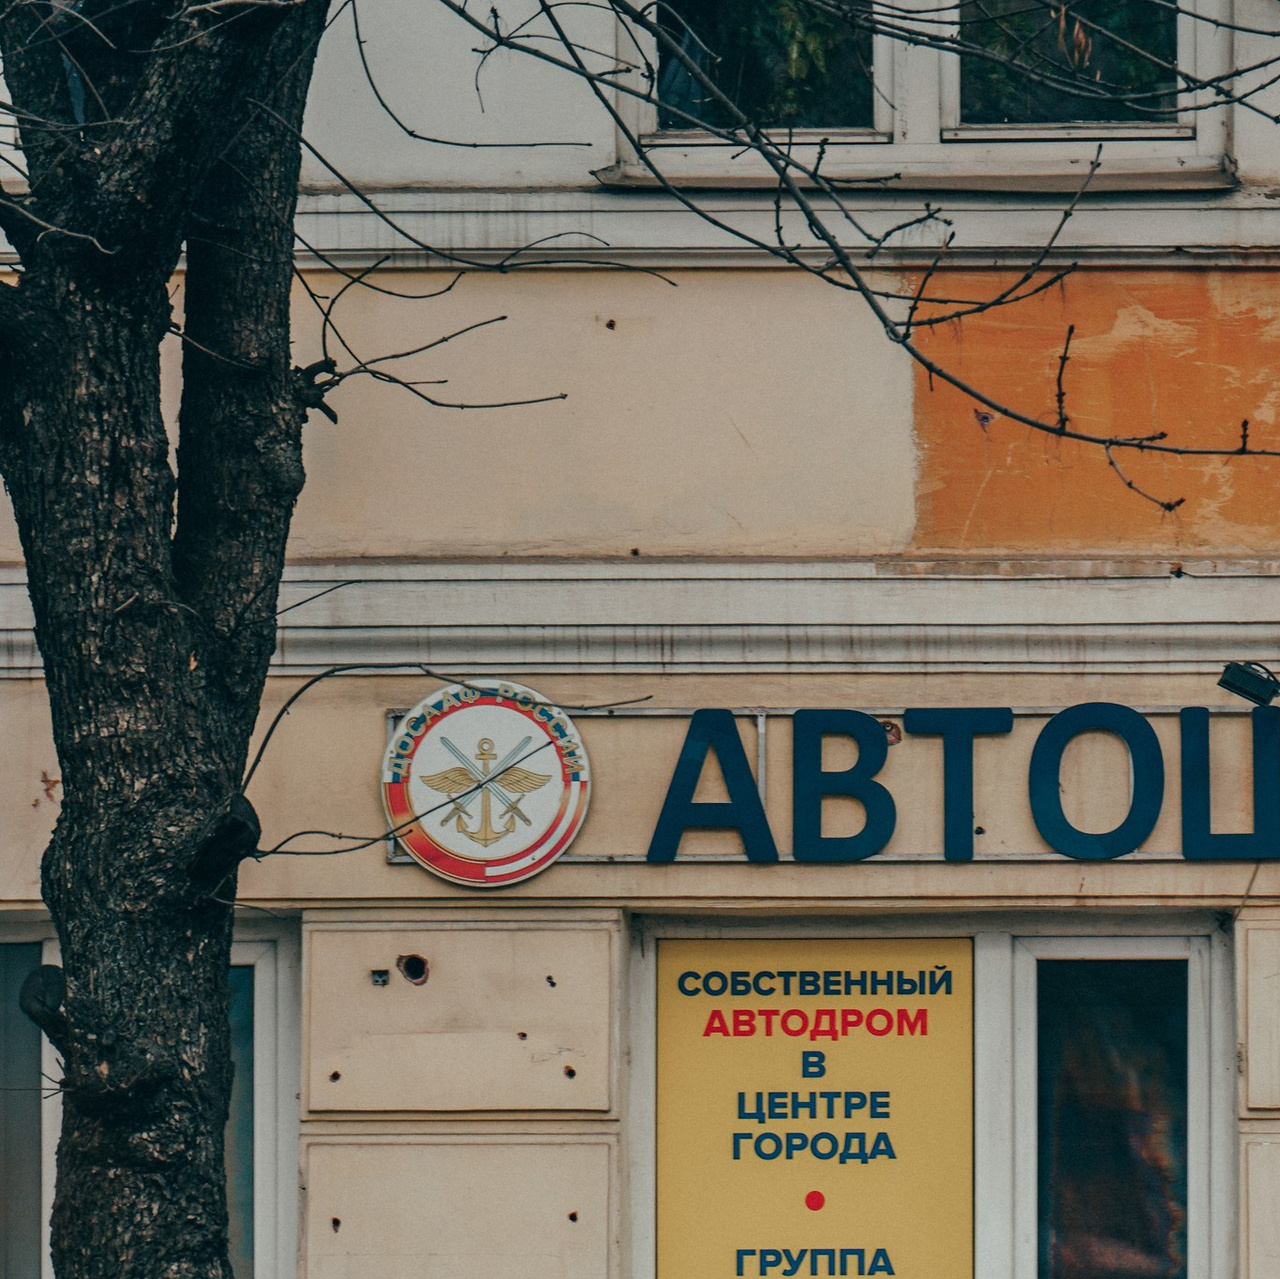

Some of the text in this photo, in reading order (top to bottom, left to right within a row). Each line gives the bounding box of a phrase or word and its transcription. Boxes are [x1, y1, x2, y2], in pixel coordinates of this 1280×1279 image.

[388, 683, 585, 777] ДОСААФ РОССИИ
[678, 965, 953, 996] СОБСТВЕННЫЙ
[703, 1008, 928, 1041] АВТОДРОМ
[802, 1051, 826, 1078] В
[738, 1091, 890, 1124] ЦЕНТРЕ
[733, 1132, 897, 1164] ГОРОДА
[736, 1249, 895, 1276] ГРУППА
